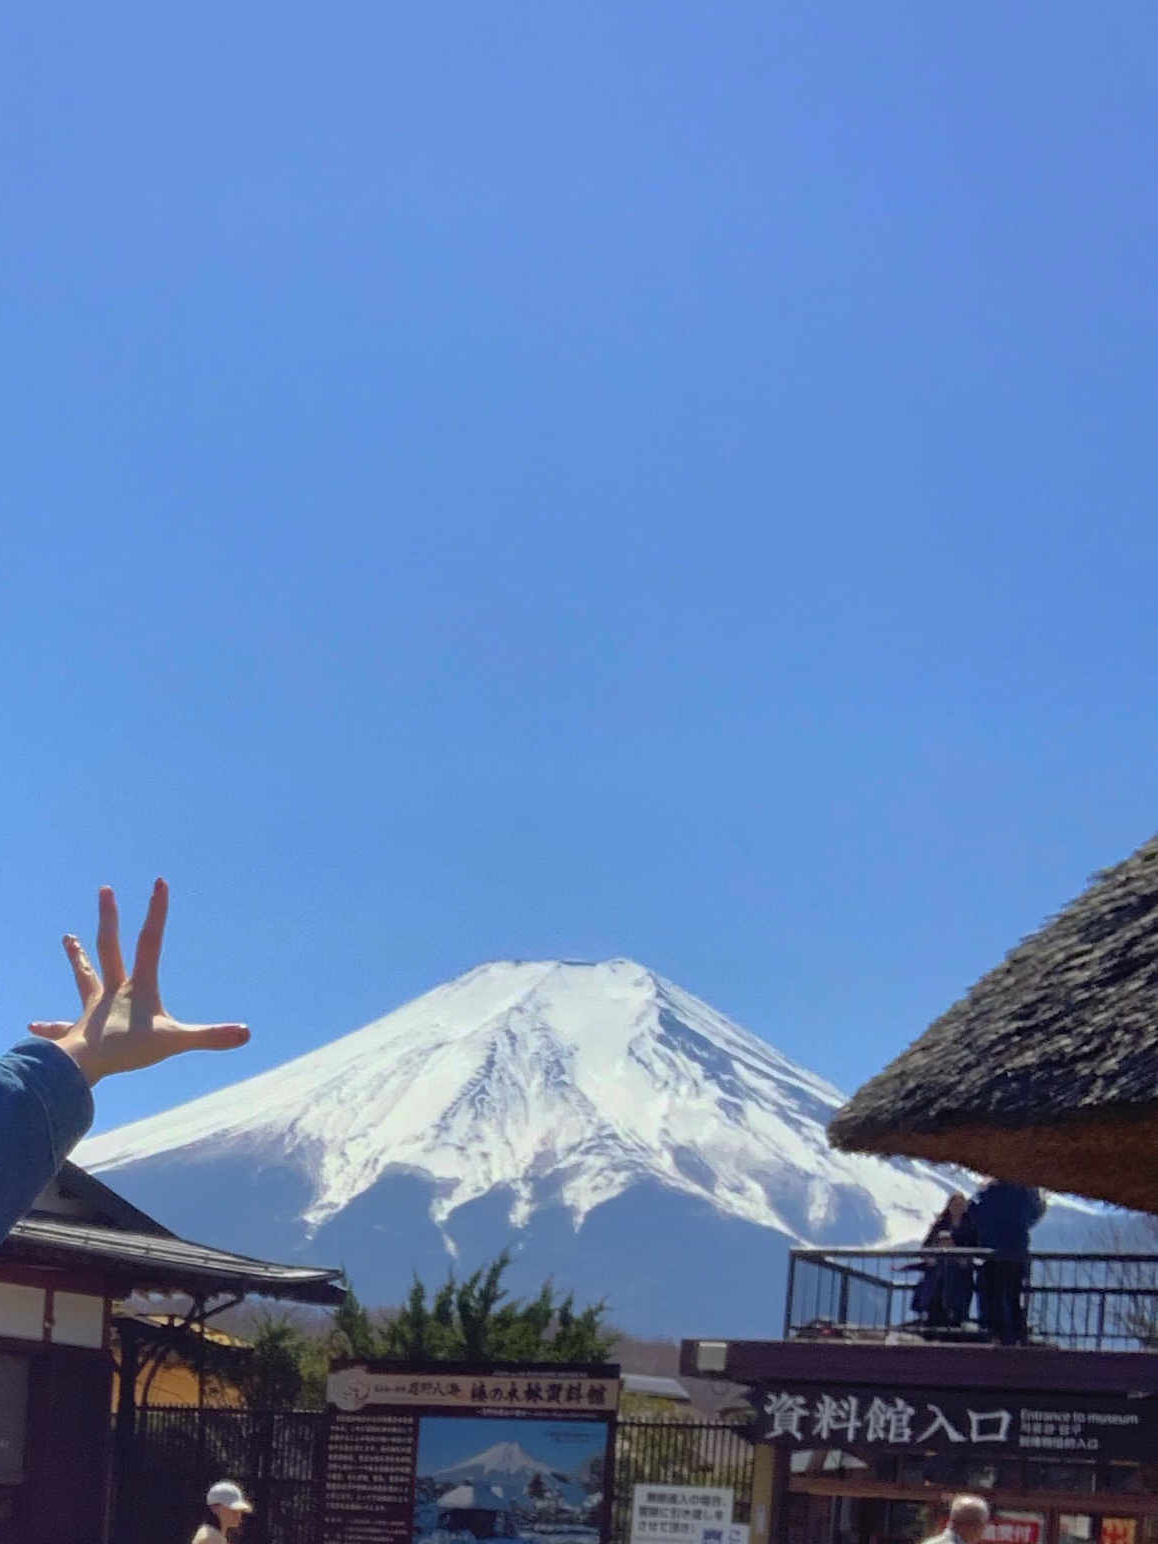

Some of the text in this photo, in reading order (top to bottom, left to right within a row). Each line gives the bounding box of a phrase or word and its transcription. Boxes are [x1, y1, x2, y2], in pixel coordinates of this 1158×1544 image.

[763, 1391, 1013, 1443] 資料館入口
[1020, 1408, 1139, 1425] Entrance to museum
